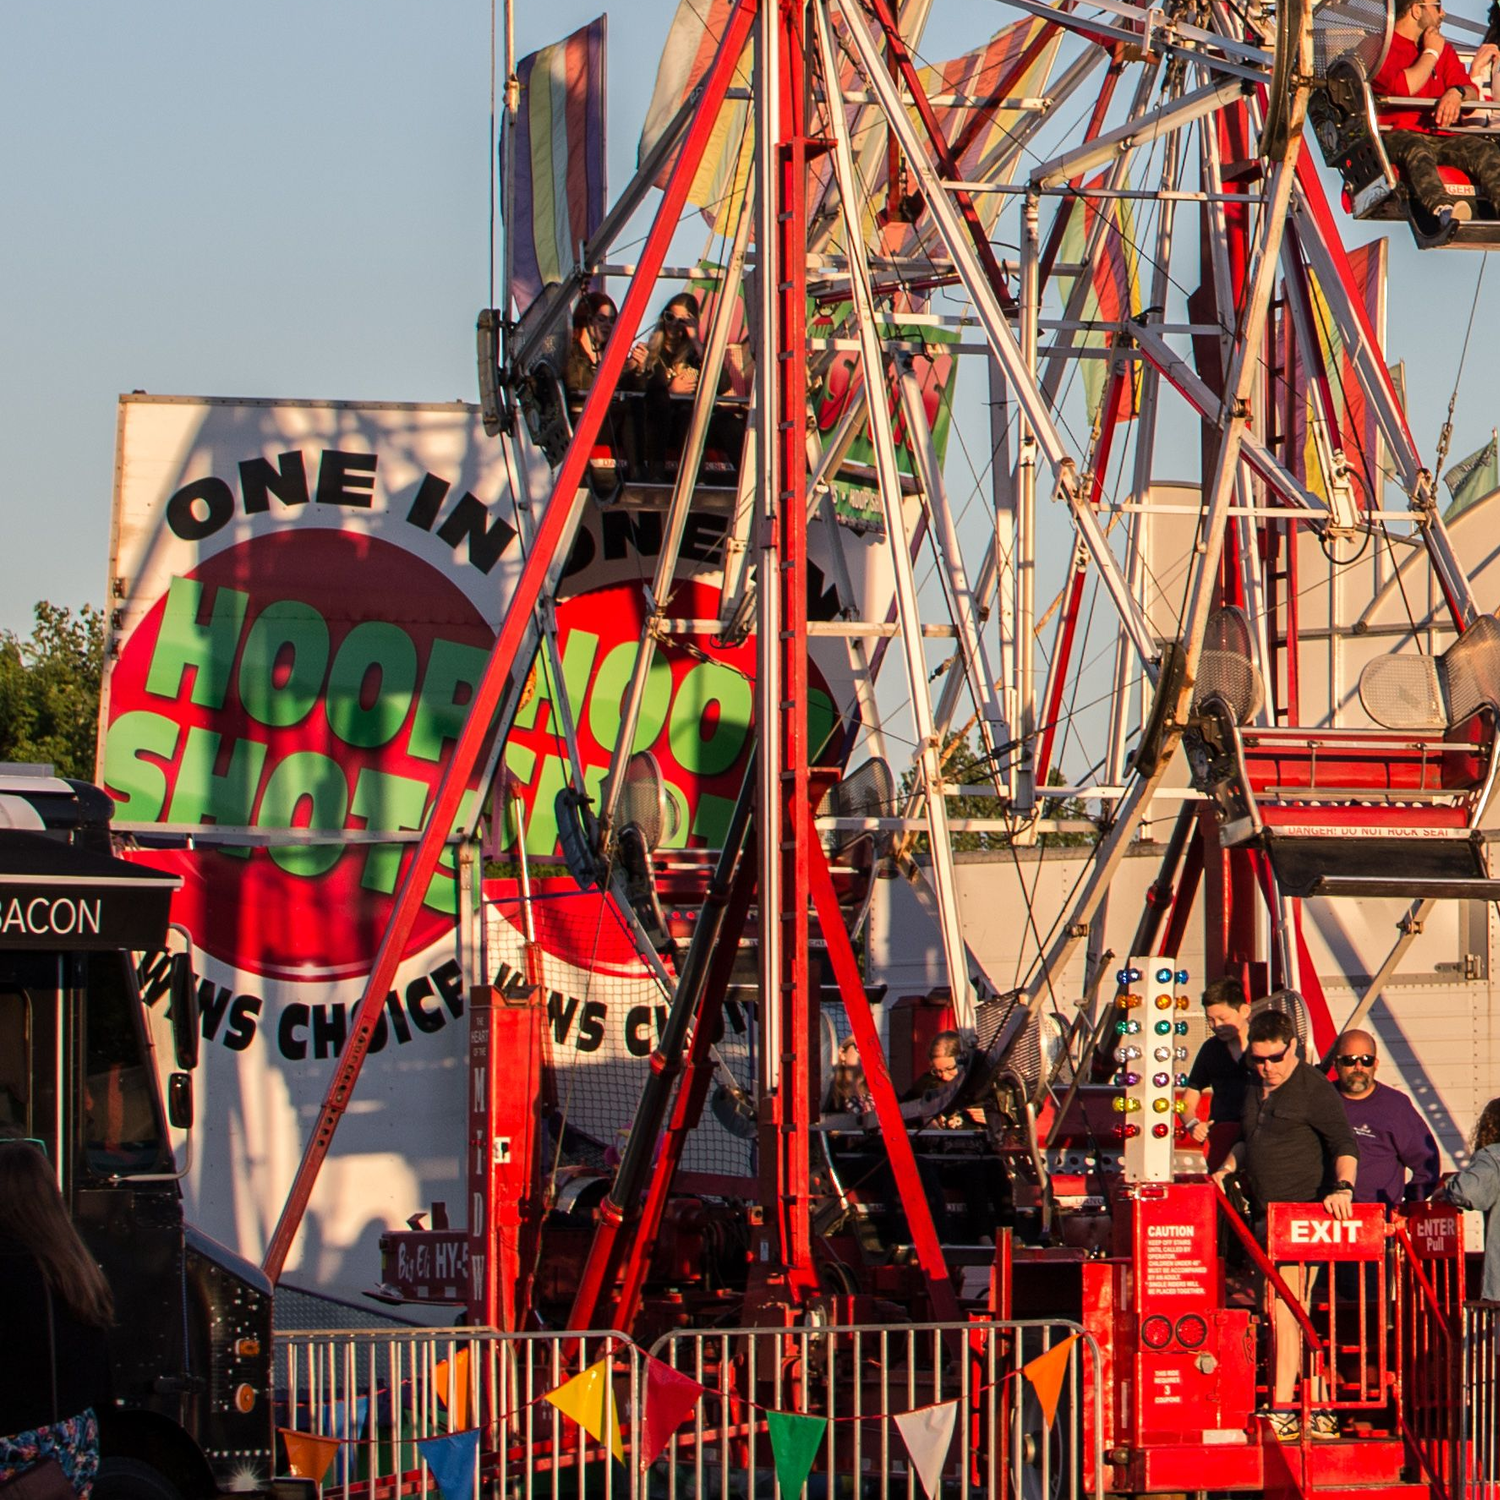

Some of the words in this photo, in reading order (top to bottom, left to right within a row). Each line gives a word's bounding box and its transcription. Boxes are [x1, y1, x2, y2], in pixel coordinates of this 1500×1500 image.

[166, 449, 378, 541] ONE
[405, 472, 519, 575] IN
[145, 575, 500, 761] HOOP
[0, 898, 101, 934] ACON
[278, 959, 465, 1061] CHOICE
[1148, 1226, 1194, 1237] CAUTION
[1291, 1220, 1363, 1243] EXIT
[1417, 1218, 1455, 1237] ENTER
[1427, 1237, 1444, 1251] Pull
[1164, 1385, 1170, 1395] 3
